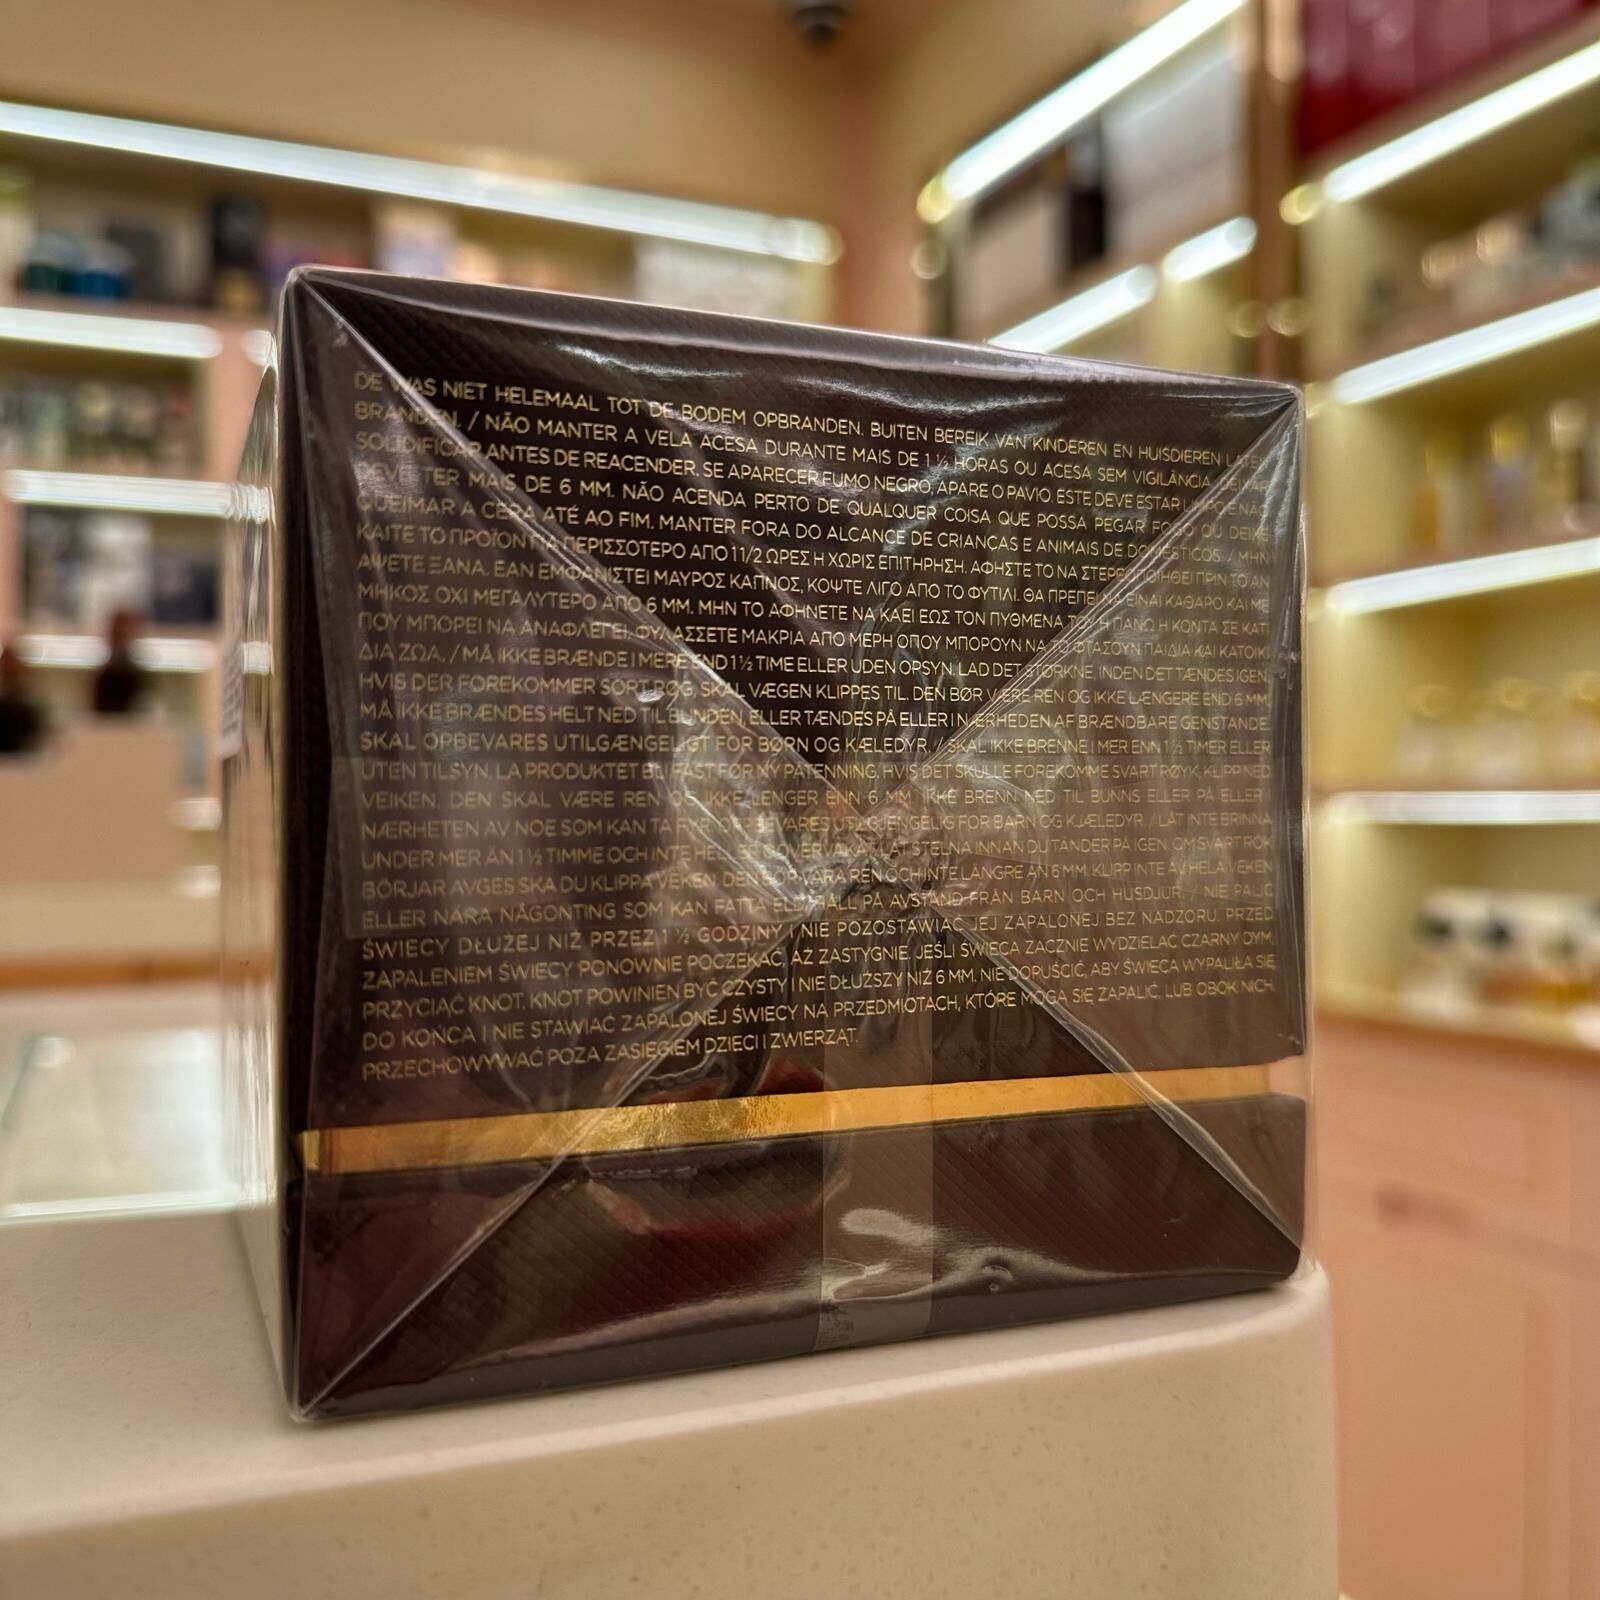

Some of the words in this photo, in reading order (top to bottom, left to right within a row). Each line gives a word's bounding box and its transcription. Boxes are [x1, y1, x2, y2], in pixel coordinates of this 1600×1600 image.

[442, 378, 488, 401] NIET
[494, 384, 600, 412] HELEMAAL
[606, 395, 642, 416] TOT
[648, 399, 673, 419] DE
[680, 403, 746, 425] BODEM
[752, 410, 864, 436] OPBRANDEN.
[869, 420, 928, 442] BUITEN
[933, 426, 989, 447] BEREIK
[994, 432, 1026, 450] VAN
[1031, 435, 1107, 457] KINDEREN
[1112, 442, 1132, 459] EN
[1137, 444, 1220, 466] HUISDIEREN
[483, 410, 531, 434] NÃO
[535, 417, 618, 442] MANTER
[624, 425, 639, 444] A
[644, 427, 693, 448] VELA
[699, 432, 757, 454] ACESA
[764, 438, 847, 461] DURANTE
[851, 446, 892, 465] MAIS
[896, 449, 919, 467] DE
[953, 454, 1009, 474] HORAS
[1013, 459, 1037, 476] OU
[1042, 461, 1092, 481] ACESA
[1096, 466, 1127, 483] SEM
[486, 442, 550, 465] ANTES
[553, 448, 580, 467] DE
[583, 451, 700, 476] REACENDER.
[702, 460, 724, 479] SE
[727, 463, 820, 486] APARECER
[822, 470, 871, 490] FUMO
[873, 474, 934, 497] NEGRO,
[936, 479, 988, 498] APARE
[991, 483, 1005, 500] O
[1007, 484, 1054, 503] PAVIO.
[1056, 488, 1091, 506] ESTE
[1094, 490, 1134, 509] DEVE
[1136, 493, 1180, 512] ESTAR
[524, 474, 553, 494] DE
[558, 477, 571, 495] 6
[579, 479, 615, 498] MM.
[622, 479, 665, 502] NÃO
[671, 486, 746, 508] ACENDA
[753, 492, 810, 512] PERTO
[816, 497, 840, 514] DE
[846, 499, 937, 521] QUALQUER
[943, 505, 991, 524] COISA
[997, 509, 1030, 527] QUE
[1036, 512, 1087, 530] POSSA
[1093, 515, 1145, 534] PEGAR
[541, 502, 580, 524] ATÉ
[583, 507, 614, 527] AO
[618, 510, 654, 529] FIM.
[658, 513, 736, 534] MANTER
[740, 518, 790, 538] FORA
[794, 522, 822, 540] DO
[826, 524, 905, 545] ALCANCE
[910, 529, 933, 546] DE
[936, 531, 1018, 553] CRIANÇAS
[1022, 536, 1032, 552] E
[1035, 537, 1099, 556] ANIMAIS
[1103, 541, 1123, 557] DE
[688, 543, 729, 561] ΑΠΟ
[765, 547, 810, 566] ΩΡΕΣ
[827, 551, 876, 569] ΧΩΡΙΣ
[878, 554, 967, 574] ΕΠΙΤΗΡΗΣΗ.
[969, 559, 1032, 577] ΑΦΗΣΤΕ
[1033, 562, 1054, 578] ΤΟ
[1056, 563, 1077, 580] ΝΑ
[493, 559, 535, 579] ΕΑΝ
[653, 568, 726, 589] ΜΑΥΡΟΣ
[729, 572, 804, 595] ΚΑΠΝΟΣ,
[806, 576, 862, 595] ΚΟΨΤΕ
[865, 579, 902, 597] ΛΙΓΟ
[905, 581, 940, 598] ΑΠΟ
[943, 583, 964, 600] ΤΟ
[967, 584, 1020, 602] ΦΥΤΙΛΙ.
[1022, 587, 1044, 603] ΘΑ
[601, 593, 642, 612] ΑΠΟ
[698, 598, 737, 616] ΜΗΝ
[740, 600, 764, 617] ΤΟ
[767, 601, 848, 621] ΑΦΗΝΕΤΕ
[851, 605, 875, 622] ΝΑ
[879, 606, 915, 623] ΚΑΕΙ
[918, 608, 950, 625] ΕΩΣ
[953, 609, 985, 626] ΤΟΝ
[988, 611, 1064, 629] ΠΥΘΜΕΝΑ
[740, 627, 806, 646] ΜΑΚΡΙΑ
[808, 630, 845, 647] ΑΠΟ
[849, 631, 893, 648] ΜΕΡΗ
[895, 633, 942, 650] ΟΠΟΥ
[944, 635, 1022, 652] ΜΠΟΡΟΥΝ
[1024, 637, 1046, 653] ΝΑ
[543, 648, 629, 668] BRÆNDE
[754, 655, 795, 672] TIME
[797, 656, 848, 673] ELLER
[850, 658, 897, 675] UDEN
[898, 659, 955, 676] OPSYN.
[957, 661, 990, 677] LAD
[991, 662, 1022, 678] DET
[411, 672, 454, 692] DER
[457, 674, 596, 695] FOREKOMMER
[748, 681, 812, 699] VÆGEN
[815, 683, 880, 700] KLIPPES
[883, 685, 909, 701] TIL.
[912, 685, 945, 701] DEN
[948, 686, 983, 702] BØR
[549, 704, 594, 723] HELT
[803, 709, 873, 726] TÆNDES
[875, 707, 897, 726] PÅ
[898, 711, 948, 727] ELLER
[1077, 713, 1177, 730] BRÆNDBARE
[423, 731, 549, 751] OPBEVARES
[757, 735, 809, 752] BØRN
[813, 736, 840, 752] OG
[844, 736, 930, 753] KÆLEDYR.
[1026, 738, 1088, 753] BRENNE
[525, 761, 639, 780] PRODUKTET
[1014, 763, 1109, 778] FOREKOMME
[559, 817, 603, 836] SOM
[994, 813, 1036, 829] BARN
[361, 849, 435, 870] UNDER
[622, 900, 663, 919] SOM
[1020, 888, 1065, 904] BARN
[1071, 887, 1106, 903] OCH
[361, 935, 450, 960] ŚWIECY
[589, 928, 655, 948] PRZEZ
[800, 921, 830, 938] NIE
[1003, 911, 1099, 930] ZAPALONEJ
[1105, 910, 1136, 926] BEZ
[362, 964, 493, 990] ZAPALENIEM
[578, 955, 682, 977] PONOWNIE
[789, 945, 814, 966] AŻ
[817, 944, 911, 964] ZASTYGNIE.
[914, 939, 956, 960] JEŚLI
[1024, 937, 1089, 955] ZACZNIE
[1180, 931, 1239, 948] CZARNY
[586, 983, 680, 1005] POWINIEN
[721, 977, 787, 997] CZYSTY
[798, 975, 826, 992] NIE
[906, 966, 932, 986] NIŻ
[935, 969, 945, 985] 6
[948, 967, 977, 984] MM.
[401, 1022, 475, 1048] KOŃCA
[731, 1003, 799, 1024] ŚWIECY
[803, 1001, 829, 1019] NA
[833, 994, 961, 1017] PRZEDMIOTACH,
[964, 988, 1016, 1009] KTÓRE
[362, 1045, 545, 1081] PRZECHOWYWAĆ
[546, 1044, 601, 1066] POZA
[703, 1033, 759, 1054] DZIECI
[769, 1026, 858, 1049] ZWIERZĄT.
